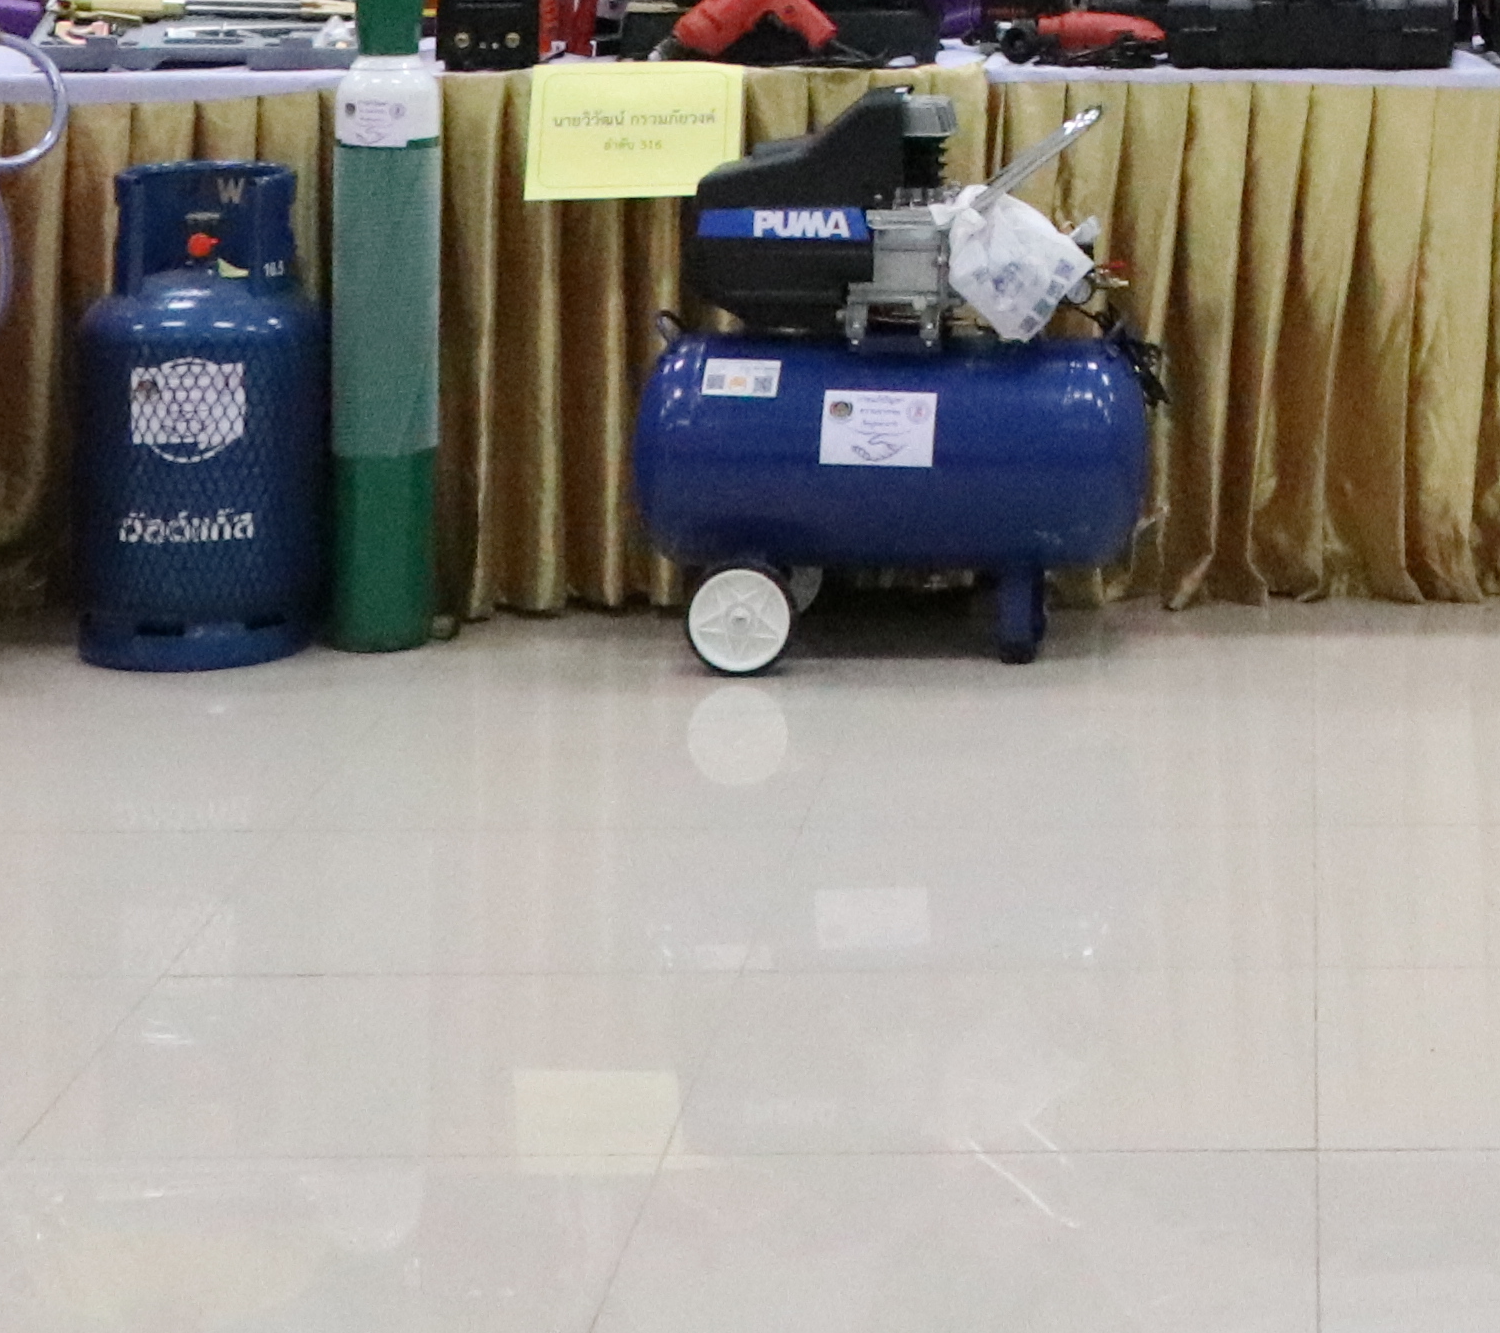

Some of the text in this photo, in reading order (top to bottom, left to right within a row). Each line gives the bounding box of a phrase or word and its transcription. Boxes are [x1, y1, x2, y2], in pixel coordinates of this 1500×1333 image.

[640, 140, 663, 150] 316
[217, 178, 245, 204] W
[753, 210, 851, 238] PUMA
